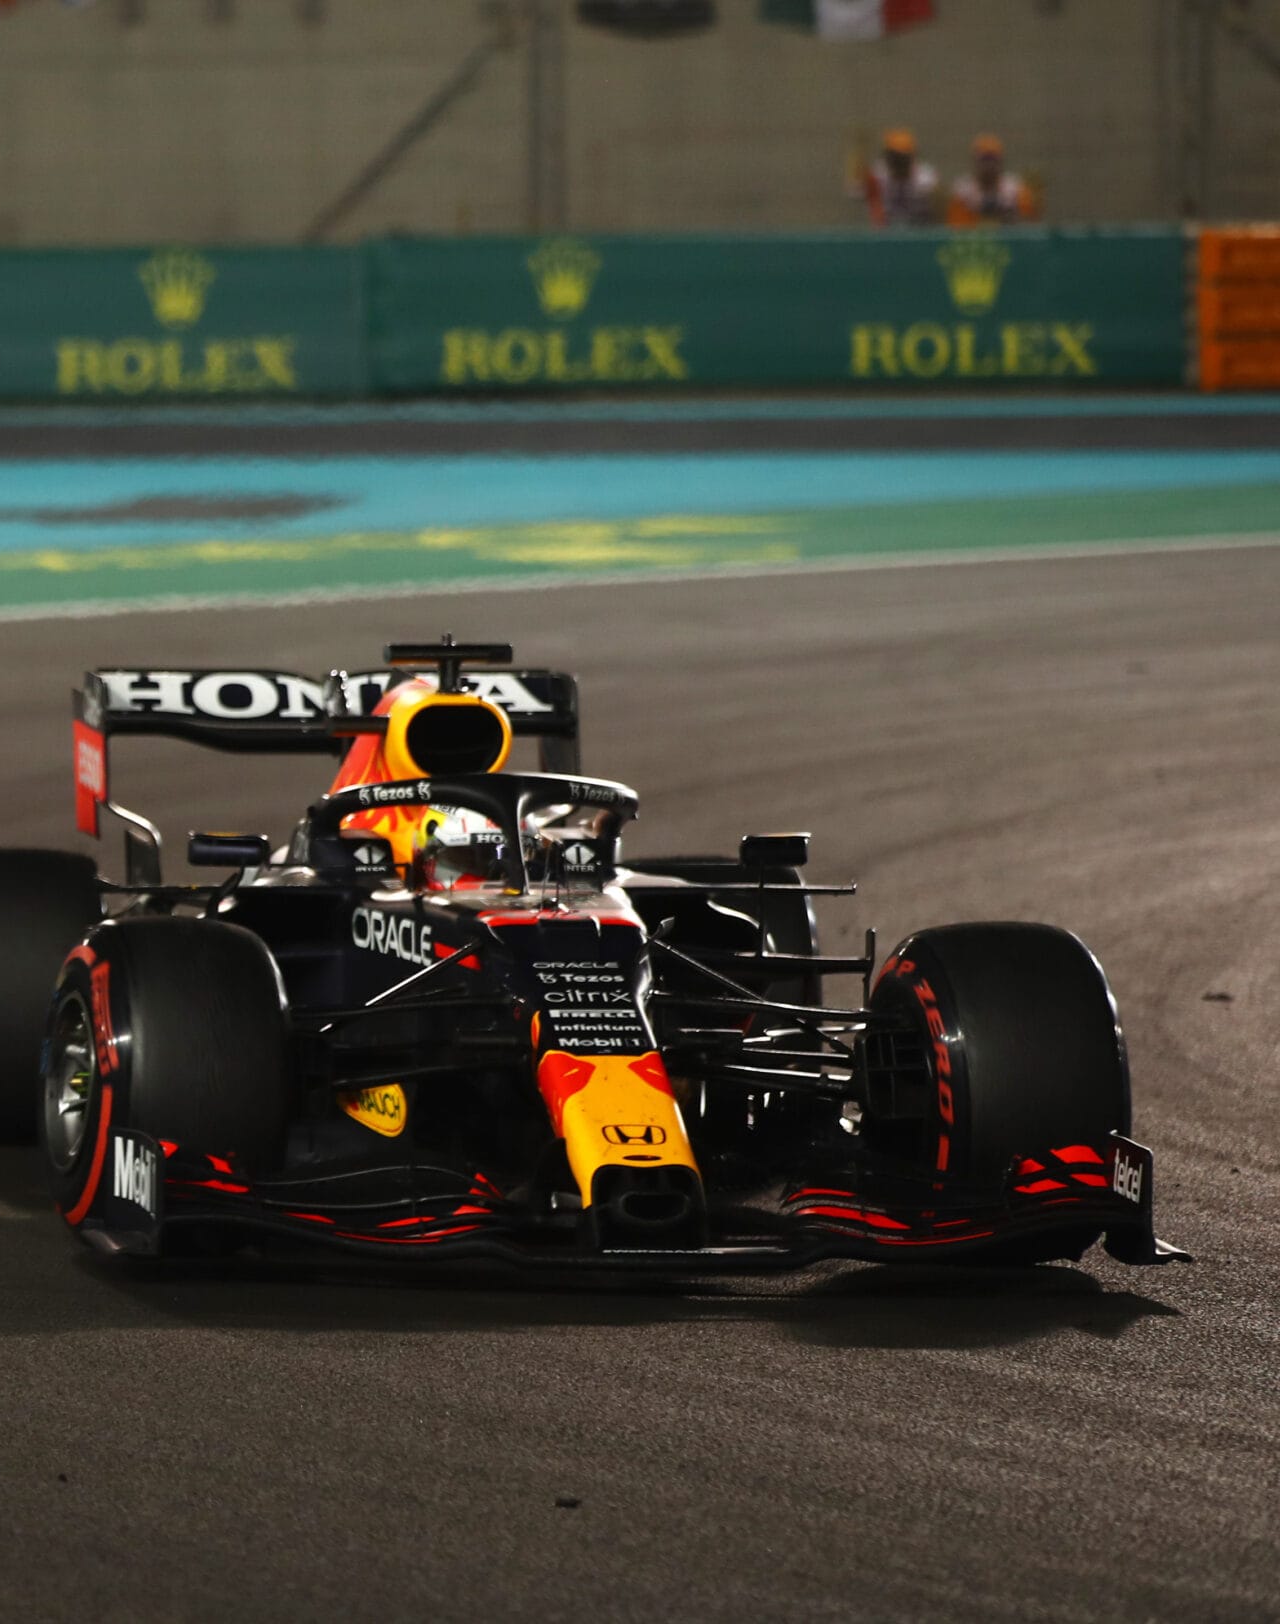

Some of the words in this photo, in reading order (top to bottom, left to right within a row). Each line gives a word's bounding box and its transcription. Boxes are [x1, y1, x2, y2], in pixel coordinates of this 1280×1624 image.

[56, 336, 298, 393] ROLEX
[442, 326, 687, 382] ROLEX
[850, 322, 1096, 377] ROLEX
[101, 671, 554, 719] HONA
[372, 785, 415, 801] Tezos
[352, 907, 432, 967] ORACLE
[532, 961, 619, 969] ORACLE
[560, 973, 625, 983] Tezos
[548, 1009, 637, 1018] PIRELLI
[558, 1038, 622, 1047] Mobil
[1113, 1148, 1143, 1204] telcel
